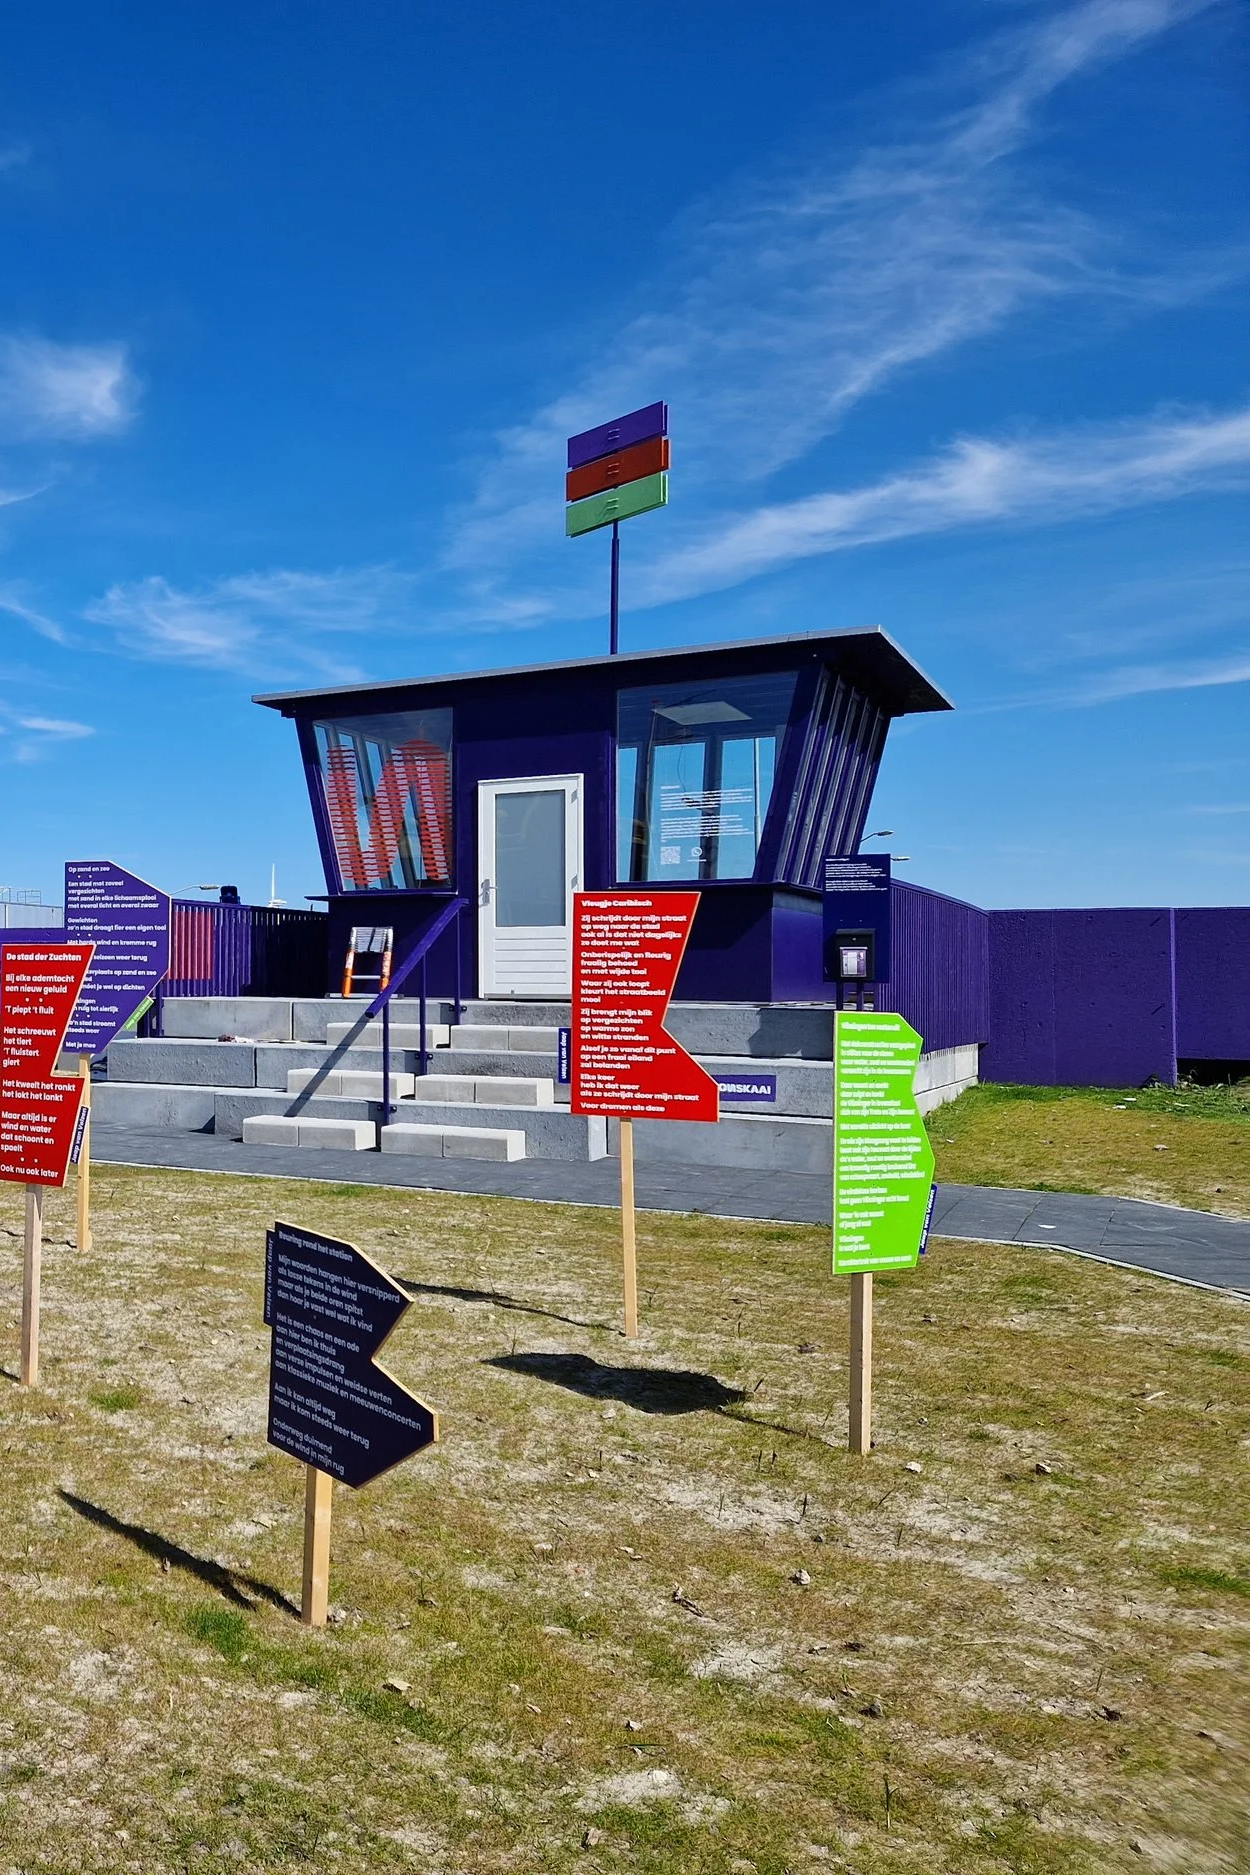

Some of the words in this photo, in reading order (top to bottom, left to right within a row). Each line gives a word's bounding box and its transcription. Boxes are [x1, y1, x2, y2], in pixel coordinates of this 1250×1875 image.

[6, 974, 14, 983] Bij
[32, 974, 74, 982] ademtocht
[20, 984, 42, 992] nieuw
[43, 985, 67, 995] geluid
[12, 1005, 31, 1015] piept
[39, 1006, 54, 1014] fluit
[17, 1027, 56, 1036] schreeuwt
[16, 1037, 32, 1045] tiert
[11, 1047, 39, 1056] fluistert
[3, 1058, 20, 1067] giert
[16, 1080, 40, 1089] kweelt
[41, 1082, 54, 1090] het
[55, 1083, 75, 1091] ronkt
[2, 1090, 14, 1098] het
[15, 1091, 29, 1099] lokt
[30, 1092, 42, 1100] het
[43, 1092, 63, 1101] lonkt
[2, 1111, 20, 1119] Maar
[21, 1113, 40, 1123] altijd
[41, 1114, 47, 1122] is
[1, 1121, 19, 1130] wind
[1, 1132, 13, 1140] dat
[14, 1134, 43, 1143] schoont
[1, 1144, 23, 1152] spoelt
[72, 1146, 80, 1162] Jaap
[0, 1164, 14, 1173] Ook
[41, 1169, 58, 1178] later
[278, 1254, 290, 1266] Mijn
[292, 1260, 317, 1274] woorden
[318, 1268, 342, 1284] hangen
[344, 1276, 357, 1288] hier
[358, 1283, 400, 1303] versnipperd
[278, 1266, 287, 1276] als
[288, 1269, 303, 1281] losse
[304, 1275, 324, 1289] tekens
[325, 1282, 331, 1292] in
[332, 1285, 340, 1295] de
[341, 1289, 357, 1301] wind
[278, 1279, 294, 1289] maar
[294, 1285, 303, 1294] als
[304, 1286, 310, 1297] je
[311, 1289, 328, 1303] beide
[329, 1298, 343, 1309] oren
[345, 1303, 363, 1316] spitst
[277, 1289, 289, 1300] dan
[290, 1293, 303, 1305] hoor
[304, 1298, 310, 1309] je
[311, 1303, 324, 1314] vast
[325, 1308, 336, 1318] wel
[337, 1313, 349, 1324] wat
[350, 1316, 356, 1326] ik
[357, 1320, 372, 1332] vind
[276, 1348, 287, 1358] aan
[288, 1354, 304, 1366] verse
[305, 1359, 334, 1380] impulsen
[335, 1375, 343, 1384] en
[344, 1378, 368, 1394] weidse
[369, 1389, 392, 1405] verten
[275, 1360, 286, 1370] aan
[288, 1364, 315, 1384] klassieke
[316, 1378, 339, 1394] muziek
[340, 1389, 348, 1399] en
[350, 1394, 421, 1431] meeuwenconcerten
[274, 1395, 290, 1408] maar
[291, 1401, 296, 1411] ik
[297, 1405, 310, 1418] kom
[312, 1414, 332, 1429] steeds
[333, 1424, 350, 1437] weer
[350, 1431, 369, 1449] terug
[273, 1417, 303, 1441] Onderweg
[304, 1434, 332, 1454] duimend
